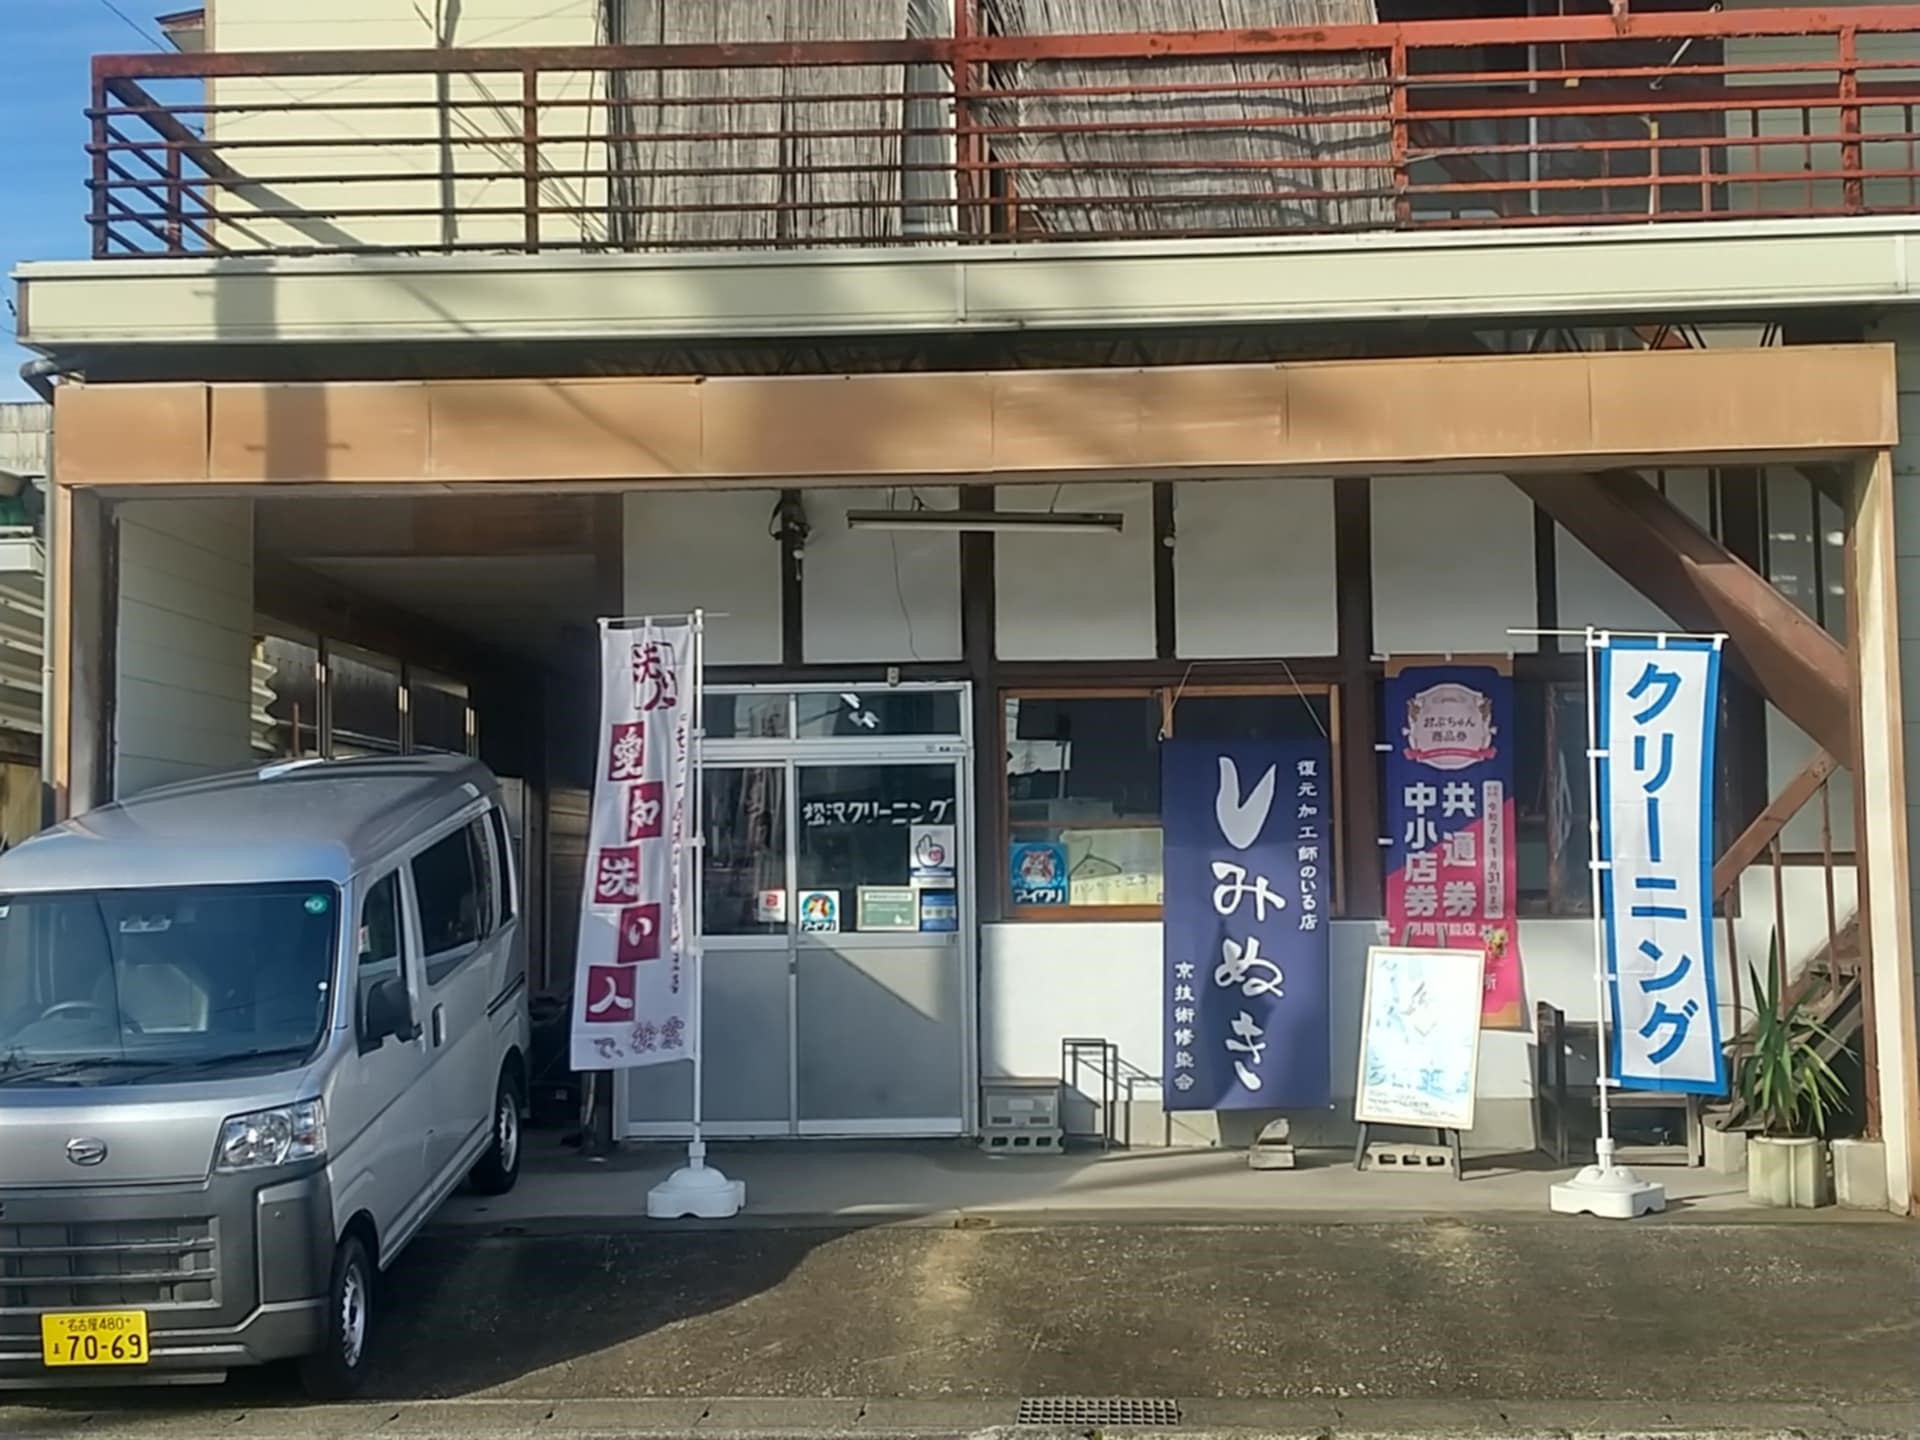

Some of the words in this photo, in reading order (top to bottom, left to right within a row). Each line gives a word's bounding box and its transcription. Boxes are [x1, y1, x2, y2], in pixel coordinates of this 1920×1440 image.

[1297, 760, 1318, 931] 復元加工師のいる店
[1404, 782, 1438, 917] 中小店券
[1442, 782, 1477, 917] 共通券
[1627, 663, 1699, 1064] クリーニング
[1209, 754, 1287, 1092] しみぬき
[66, 1333, 141, 1361] 70-69
